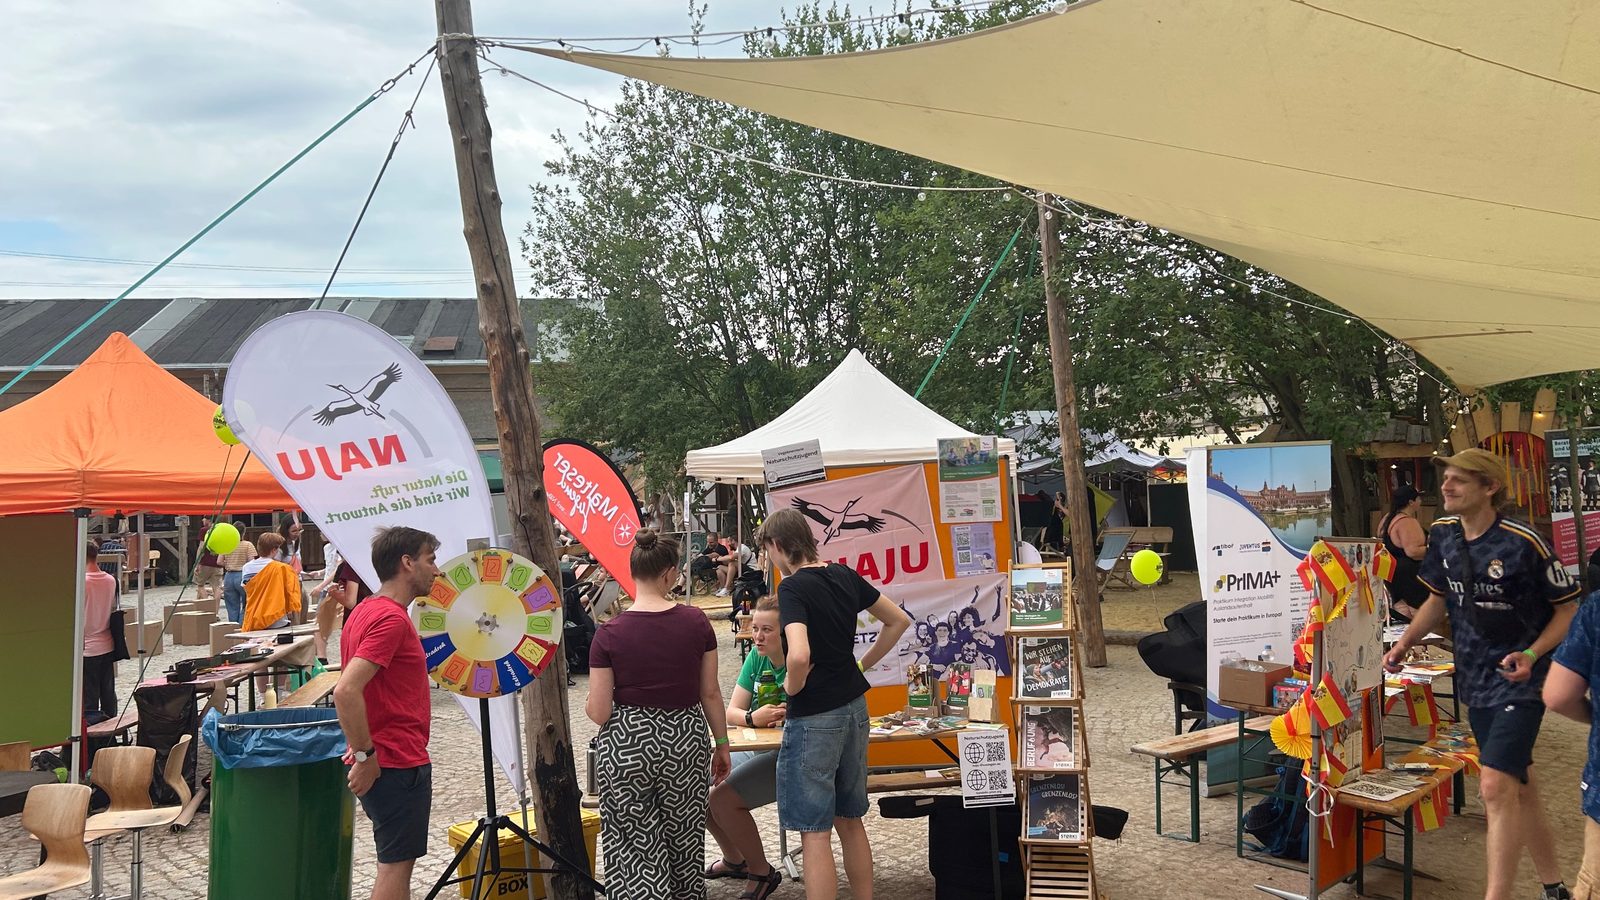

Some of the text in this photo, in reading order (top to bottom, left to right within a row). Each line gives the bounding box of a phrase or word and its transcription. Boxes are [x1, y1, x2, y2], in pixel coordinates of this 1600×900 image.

[766, 450, 818, 465] Naturschutzjugend
[824, 541, 929, 585] AJU
[1227, 570, 1282, 592] PrIMA+
[853, 631, 880, 644] ETZ
[1024, 643, 1064, 660] WIR STEHEN
[1040, 655, 1052, 664] AUF
[1026, 675, 1068, 692] DEMOKRATIE
[498, 877, 528, 896] BOX
